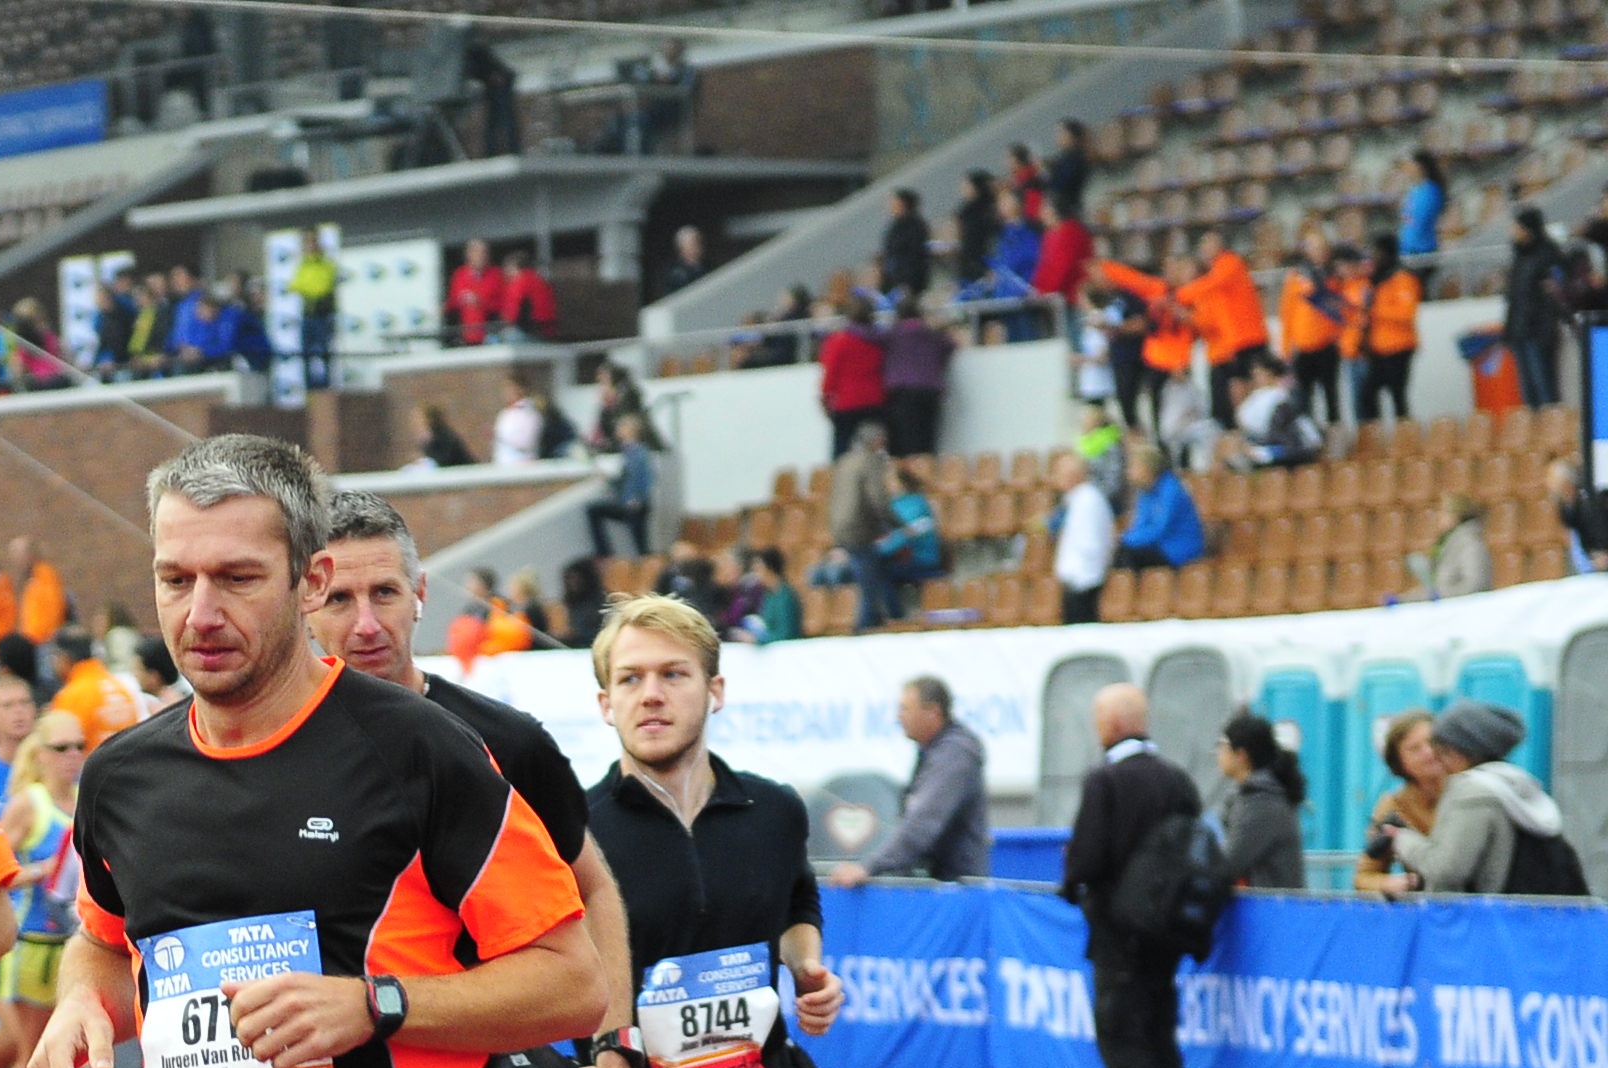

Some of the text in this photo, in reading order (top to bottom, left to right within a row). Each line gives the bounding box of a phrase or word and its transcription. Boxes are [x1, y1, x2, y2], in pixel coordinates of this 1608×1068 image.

[227, 923, 276, 945] TATA
[200, 939, 310, 969] CONSULTANCY
[219, 961, 292, 984] SERVICES
[153, 973, 192, 998] TATA
[645, 986, 689, 1004] TATA
[999, 956, 1096, 1043] TATA
[680, 997, 751, 1038] 8744
[201, 1047, 229, 1065] Van
